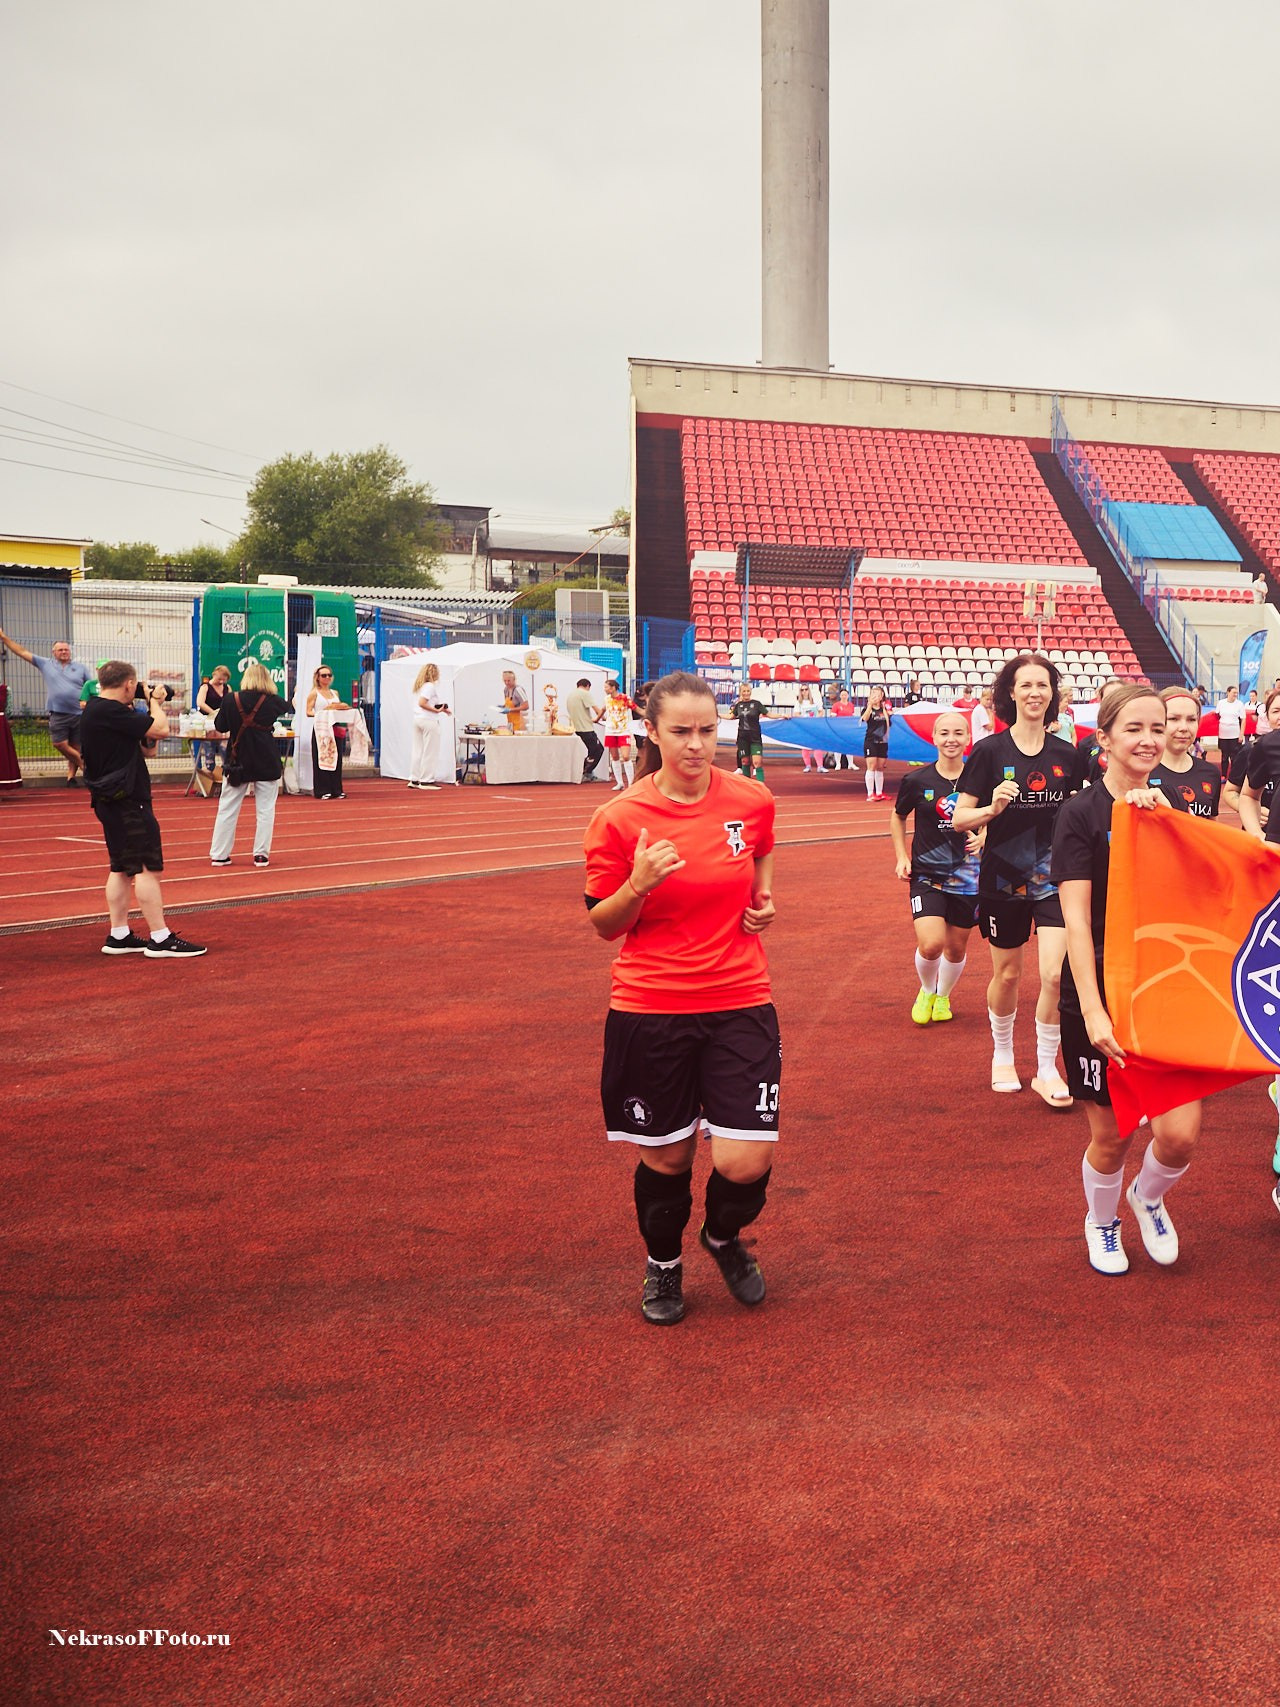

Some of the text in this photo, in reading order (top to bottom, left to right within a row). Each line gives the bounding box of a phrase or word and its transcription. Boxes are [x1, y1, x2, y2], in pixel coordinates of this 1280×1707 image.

[989, 915, 998, 938] 5
[1078, 1056, 1101, 1091] 23
[755, 1082, 779, 1112] 13
